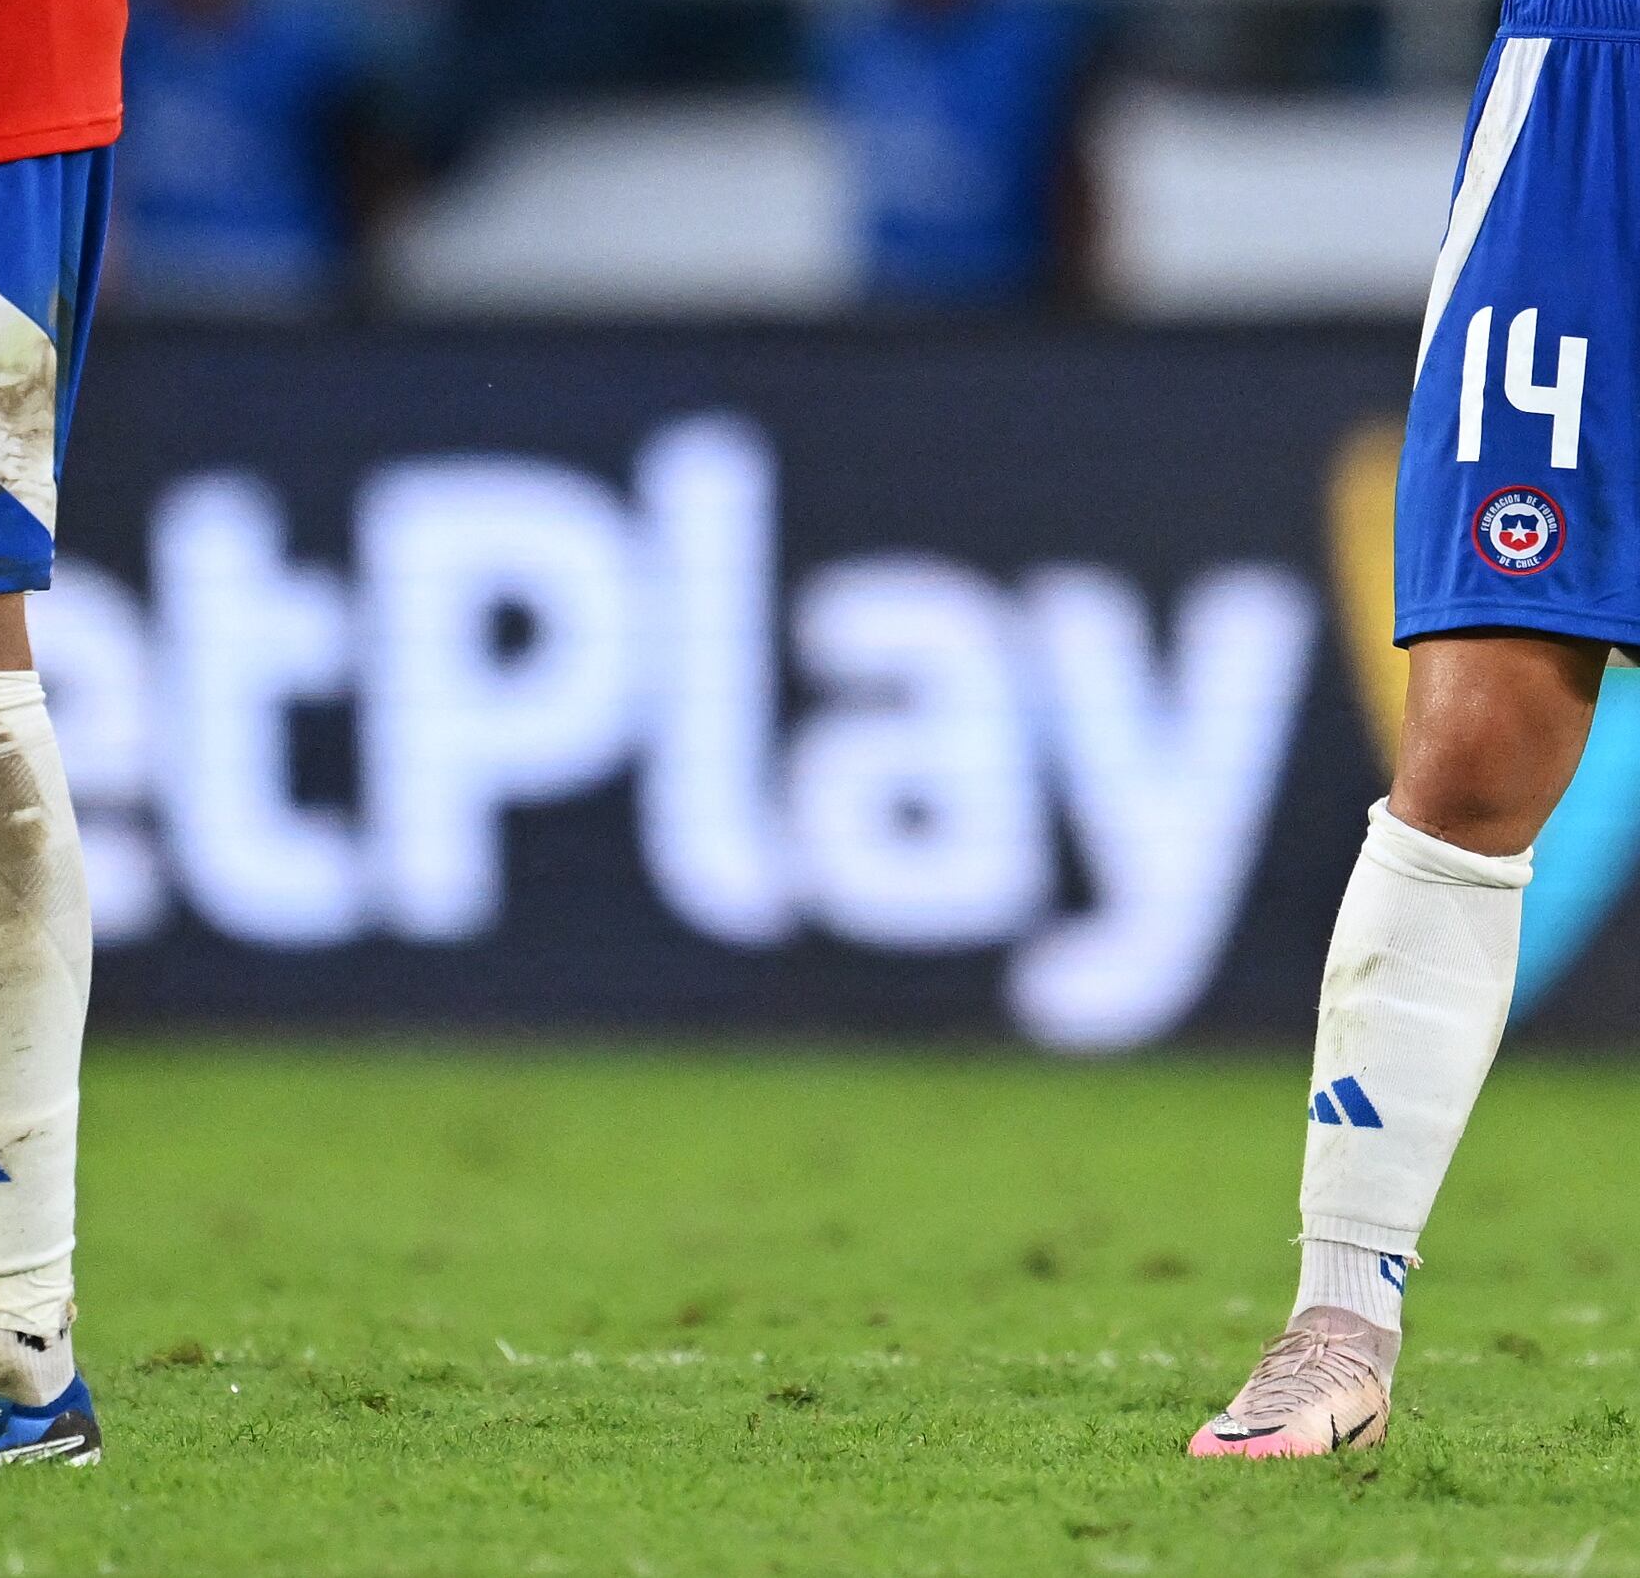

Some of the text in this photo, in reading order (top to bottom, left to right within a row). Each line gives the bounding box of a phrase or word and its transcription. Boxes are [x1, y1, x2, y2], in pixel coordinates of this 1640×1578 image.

[1456, 306, 1588, 469] 14
[1480, 494, 1558, 534] FEDERACION DE FUTBOL
[1498, 555, 1541, 568] DE CHILE
